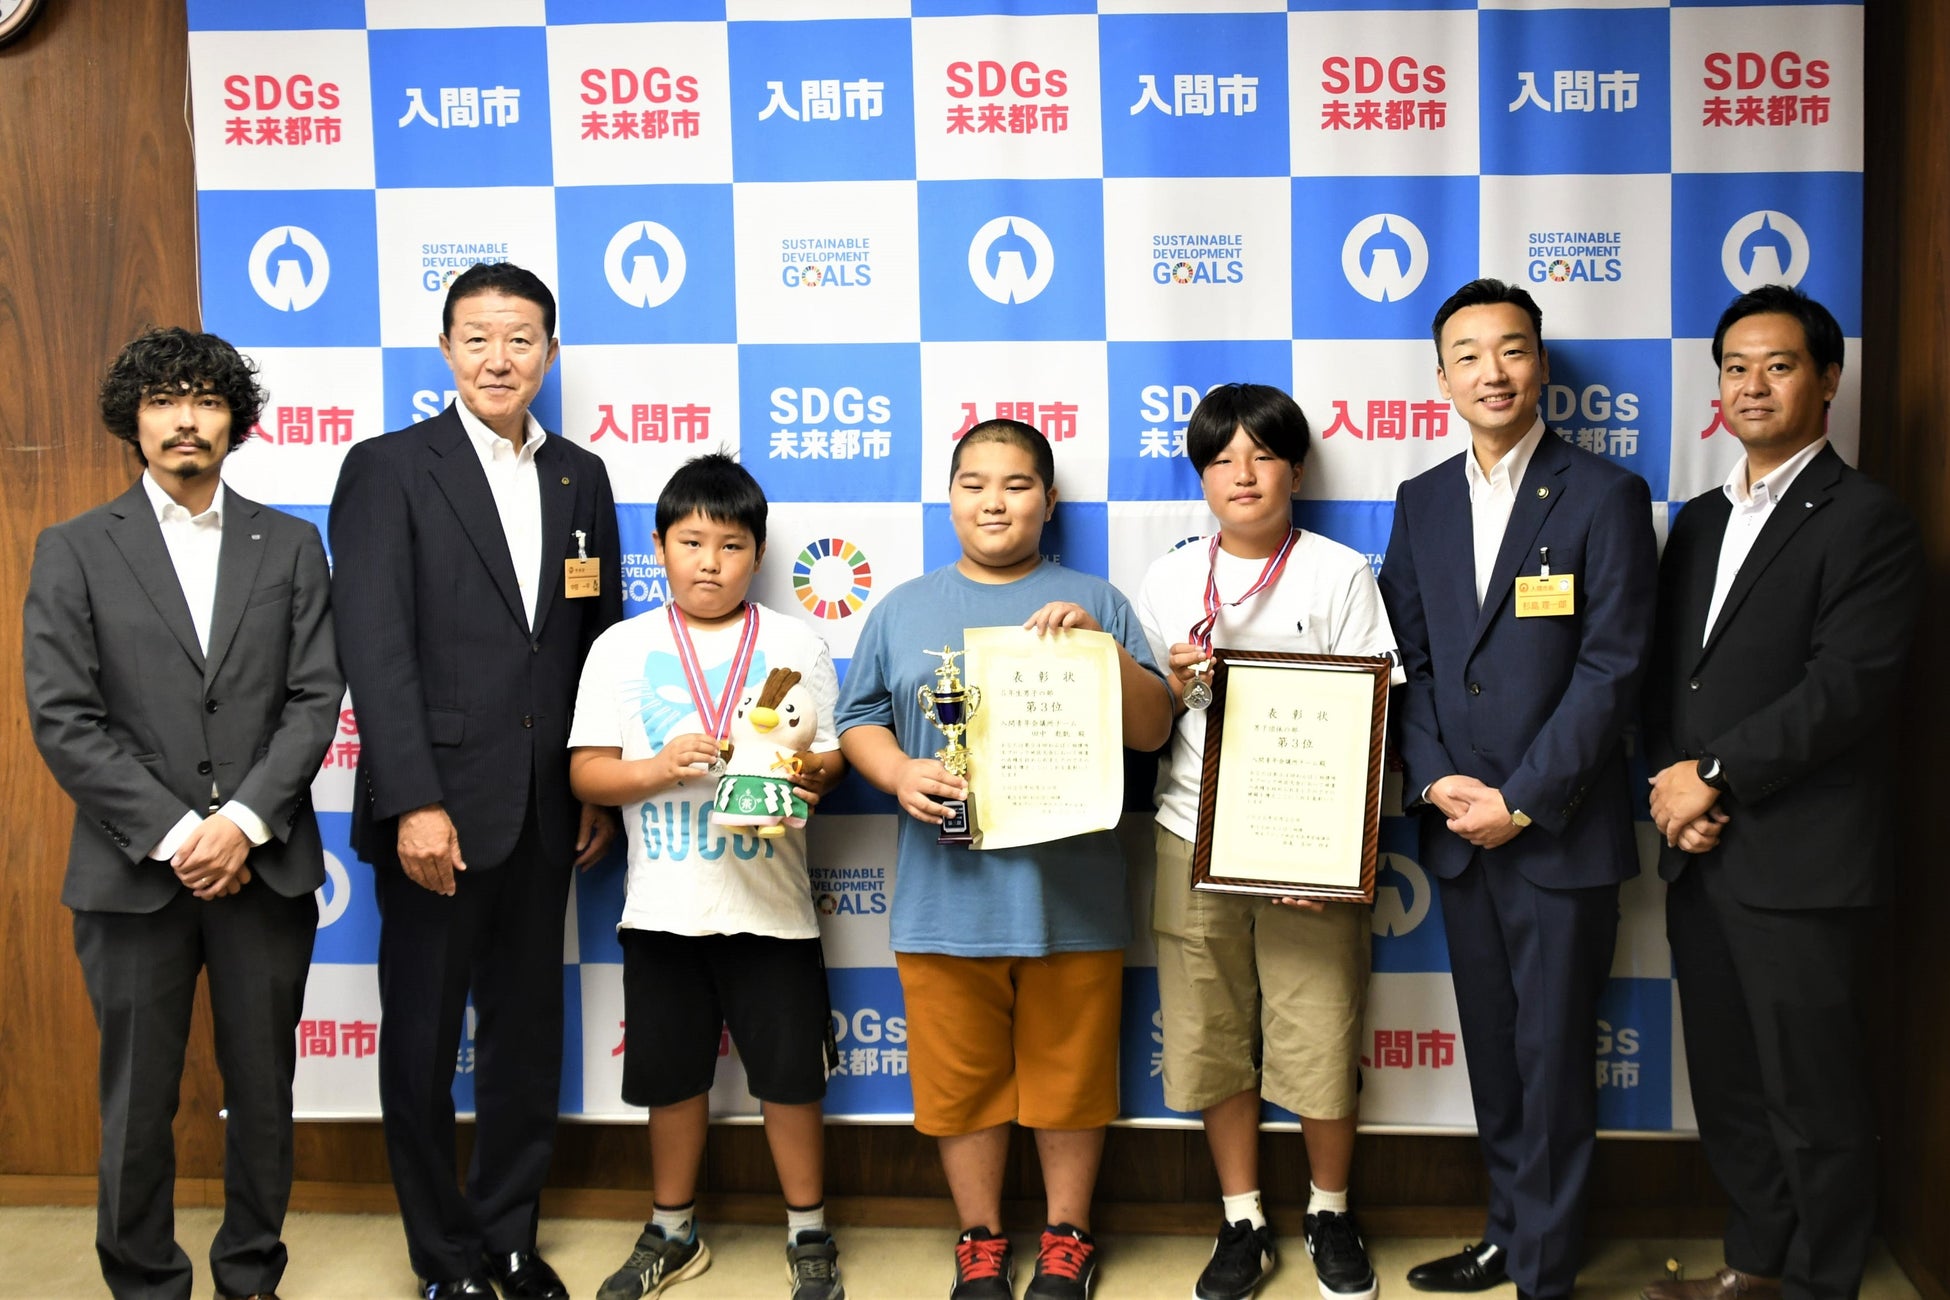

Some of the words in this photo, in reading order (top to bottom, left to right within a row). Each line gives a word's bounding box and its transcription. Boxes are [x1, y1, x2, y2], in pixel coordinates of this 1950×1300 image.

[581, 67, 699, 105] SDGs
[947, 61, 1068, 98] SDGs
[1322, 56, 1447, 94] SDGs
[1704, 51, 1830, 91] SDGs
[224, 74, 341, 111] SDGs
[399, 86, 520, 128] 入間市
[759, 79, 884, 122] 入間市
[1130, 74, 1259, 116] 入間市
[1509, 70, 1640, 112] 入間市
[581, 109, 700, 140] 未来都市
[946, 104, 1069, 134] 未来都市
[1321, 100, 1447, 130] 未来都市
[1703, 95, 1831, 127] 未来都市
[224, 116, 342, 146] 未来都市
[422, 243, 508, 254] SUSTAINABLE
[782, 238, 870, 249] SUSTAINABLE
[1153, 235, 1242, 246] SUSTAINABLE
[1153, 248, 1242, 259] DEVELOPMENT
[1528, 232, 1621, 244] SUSTAINABLE
[1528, 246, 1621, 257] DEVELOPMENT
[782, 251, 870, 262] DEVELOPMENT
[769, 386, 892, 425] SDGs
[1140, 385, 1207, 423] SD
[1537, 384, 1639, 422] DGs
[590, 403, 711, 443] 入間市
[1322, 399, 1451, 441] 入間市
[768, 428, 893, 460] 未来都市
[1555, 427, 1640, 458] 都市
[1013, 671, 1076, 683] 表彰状
[1267, 707, 1329, 722] 表彰状
[808, 867, 885, 879] USTAINABLE
[811, 880, 885, 892] VELOPMENT
[812, 892, 887, 916] OALS
[299, 1020, 377, 1059] 間市
[831, 1008, 907, 1043] DGs
[1596, 1019, 1640, 1055] Gs
[1360, 1029, 1456, 1069] 間市
